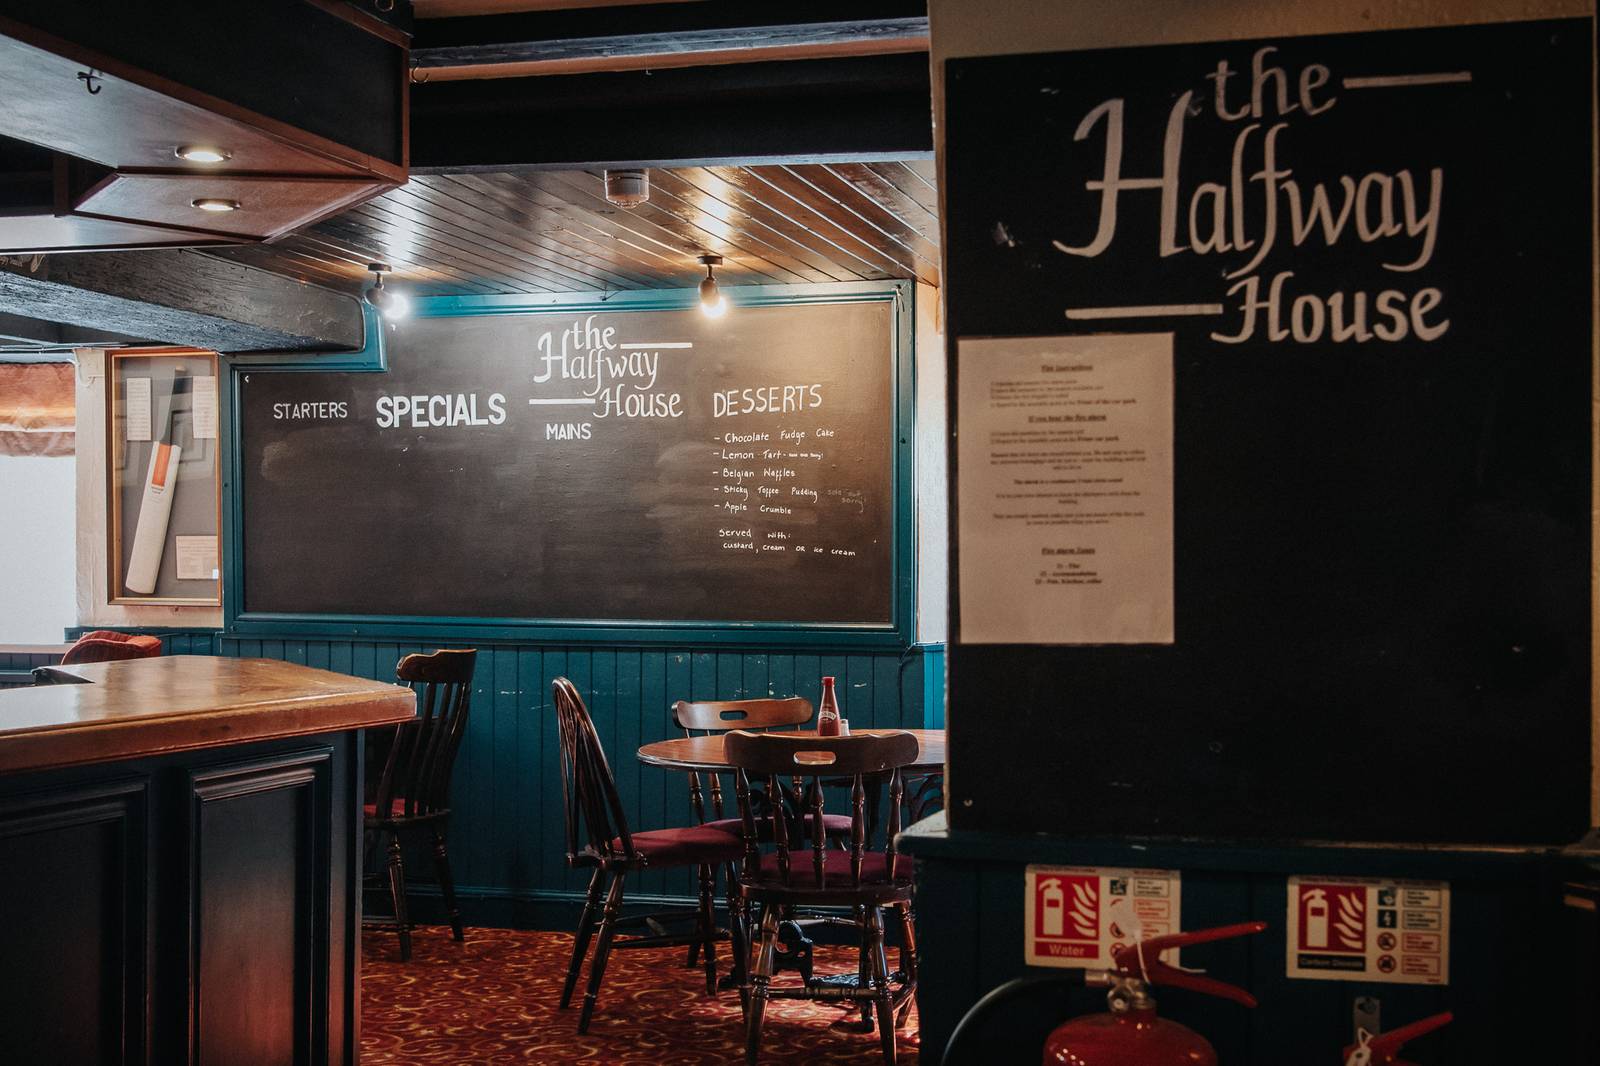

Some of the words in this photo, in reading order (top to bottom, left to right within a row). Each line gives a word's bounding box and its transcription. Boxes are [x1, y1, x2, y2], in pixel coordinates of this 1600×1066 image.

[1206, 46, 1336, 122] the
[1053, 90, 1443, 280] Halfway
[1211, 271, 1450, 344] House
[570, 315, 617, 350] the
[533, 328, 658, 396] Halfway
[593, 383, 684, 418] House
[713, 384, 822, 418] DESSERTS
[273, 402, 348, 420] STARTERS
[376, 393, 507, 429] SPECIALS
[546, 423, 592, 440] MAINS
[725, 432, 769, 443] Chocolate
[780, 429, 806, 446] Fudge
[816, 428, 834, 437] Cake
[722, 449, 754, 460] Lemon
[723, 467, 755, 485] Belgian
[723, 485, 749, 501] Sticky
[757, 485, 780, 498] Toffee
[791, 486, 818, 504] Pudding
[724, 501, 748, 514] Apple
[760, 504, 792, 515] Crumble
[719, 529, 752, 538] Served
[1049, 945, 1085, 956] Water
